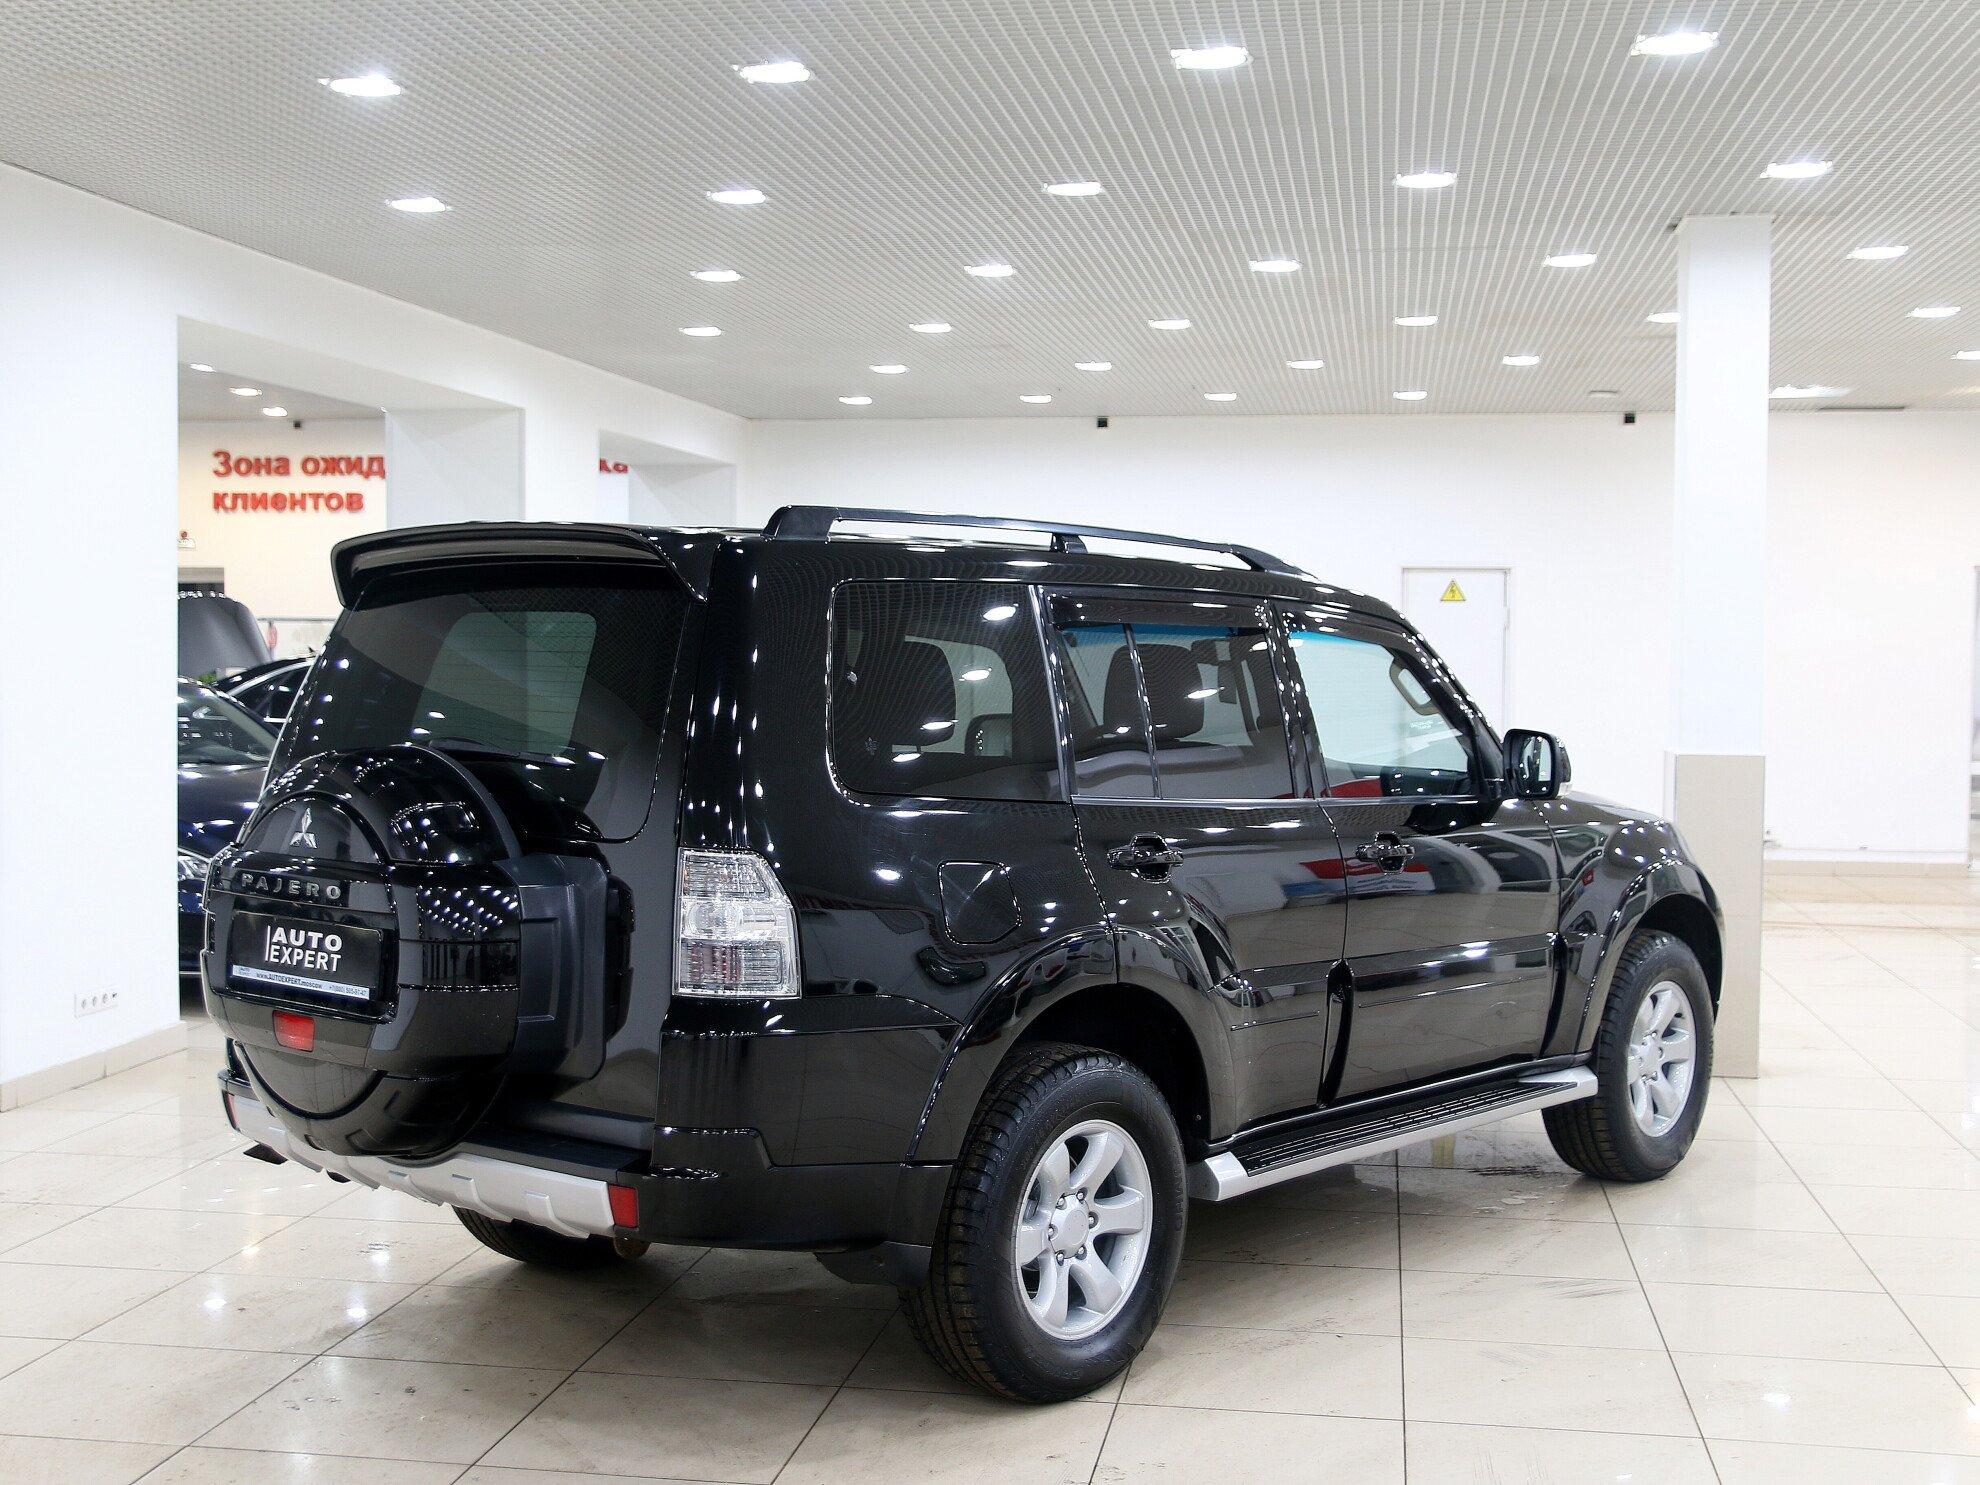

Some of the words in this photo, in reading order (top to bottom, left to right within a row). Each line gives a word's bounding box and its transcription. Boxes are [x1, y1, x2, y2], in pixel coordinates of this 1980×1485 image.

[213, 450, 290, 477] Зона
[301, 456, 386, 480] ожид
[212, 492, 365, 512] клиентов
[241, 873, 342, 900] PAJERO
[271, 926, 343, 952] AUTO
[269, 944, 342, 972] EXPERT
